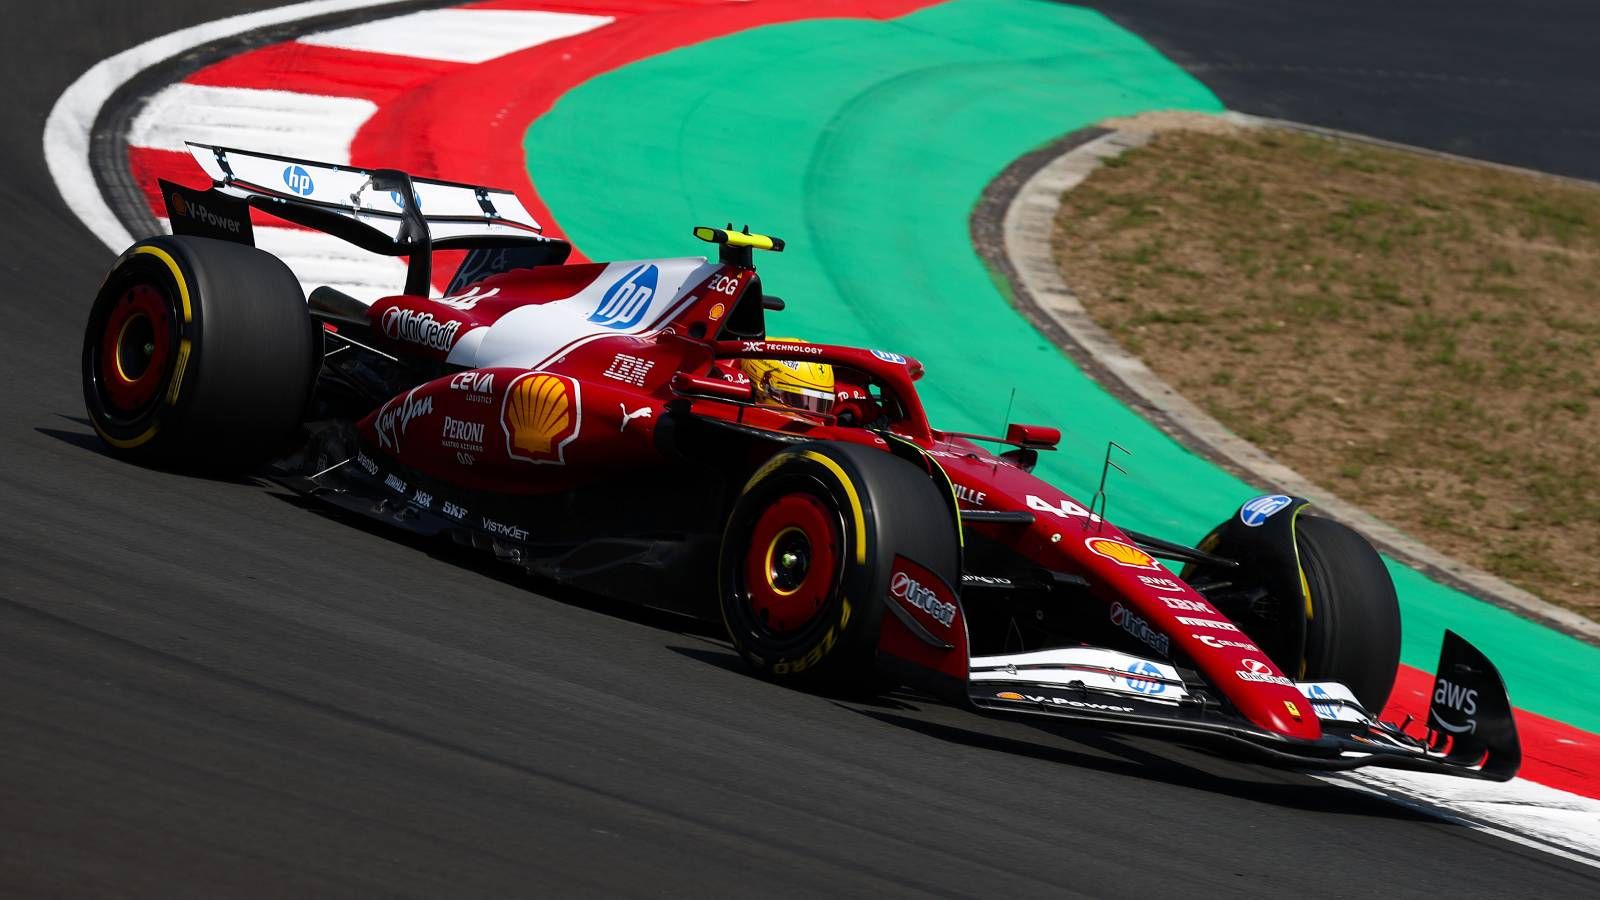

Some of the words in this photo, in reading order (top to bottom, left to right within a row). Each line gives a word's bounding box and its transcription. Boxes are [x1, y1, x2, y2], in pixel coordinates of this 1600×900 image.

[286, 165, 312, 196] hp
[185, 200, 241, 233] V-Power
[590, 264, 655, 327] hp
[708, 274, 738, 296] ZCG
[400, 309, 461, 351] UniCredit
[766, 343, 823, 356] TECHNOLOGY
[603, 353, 655, 387] IBM
[466, 393, 492, 405] LOGISTICS
[442, 416, 485, 443] PERONI
[357, 448, 379, 475] brembo
[384, 473, 407, 493] MAHLE
[413, 489, 433, 508] NGK
[442, 501, 469, 519] SKF
[1025, 494, 1103, 523] 44
[1244, 497, 1288, 525] hp
[1137, 575, 1179, 589] aws
[905, 579, 957, 629] UniCredit
[1158, 596, 1215, 615] IBM
[1129, 662, 1163, 693] hp
[1235, 670, 1296, 688] UniCredit
[1025, 694, 1134, 713] V-Power
[1434, 678, 1478, 715] aws
